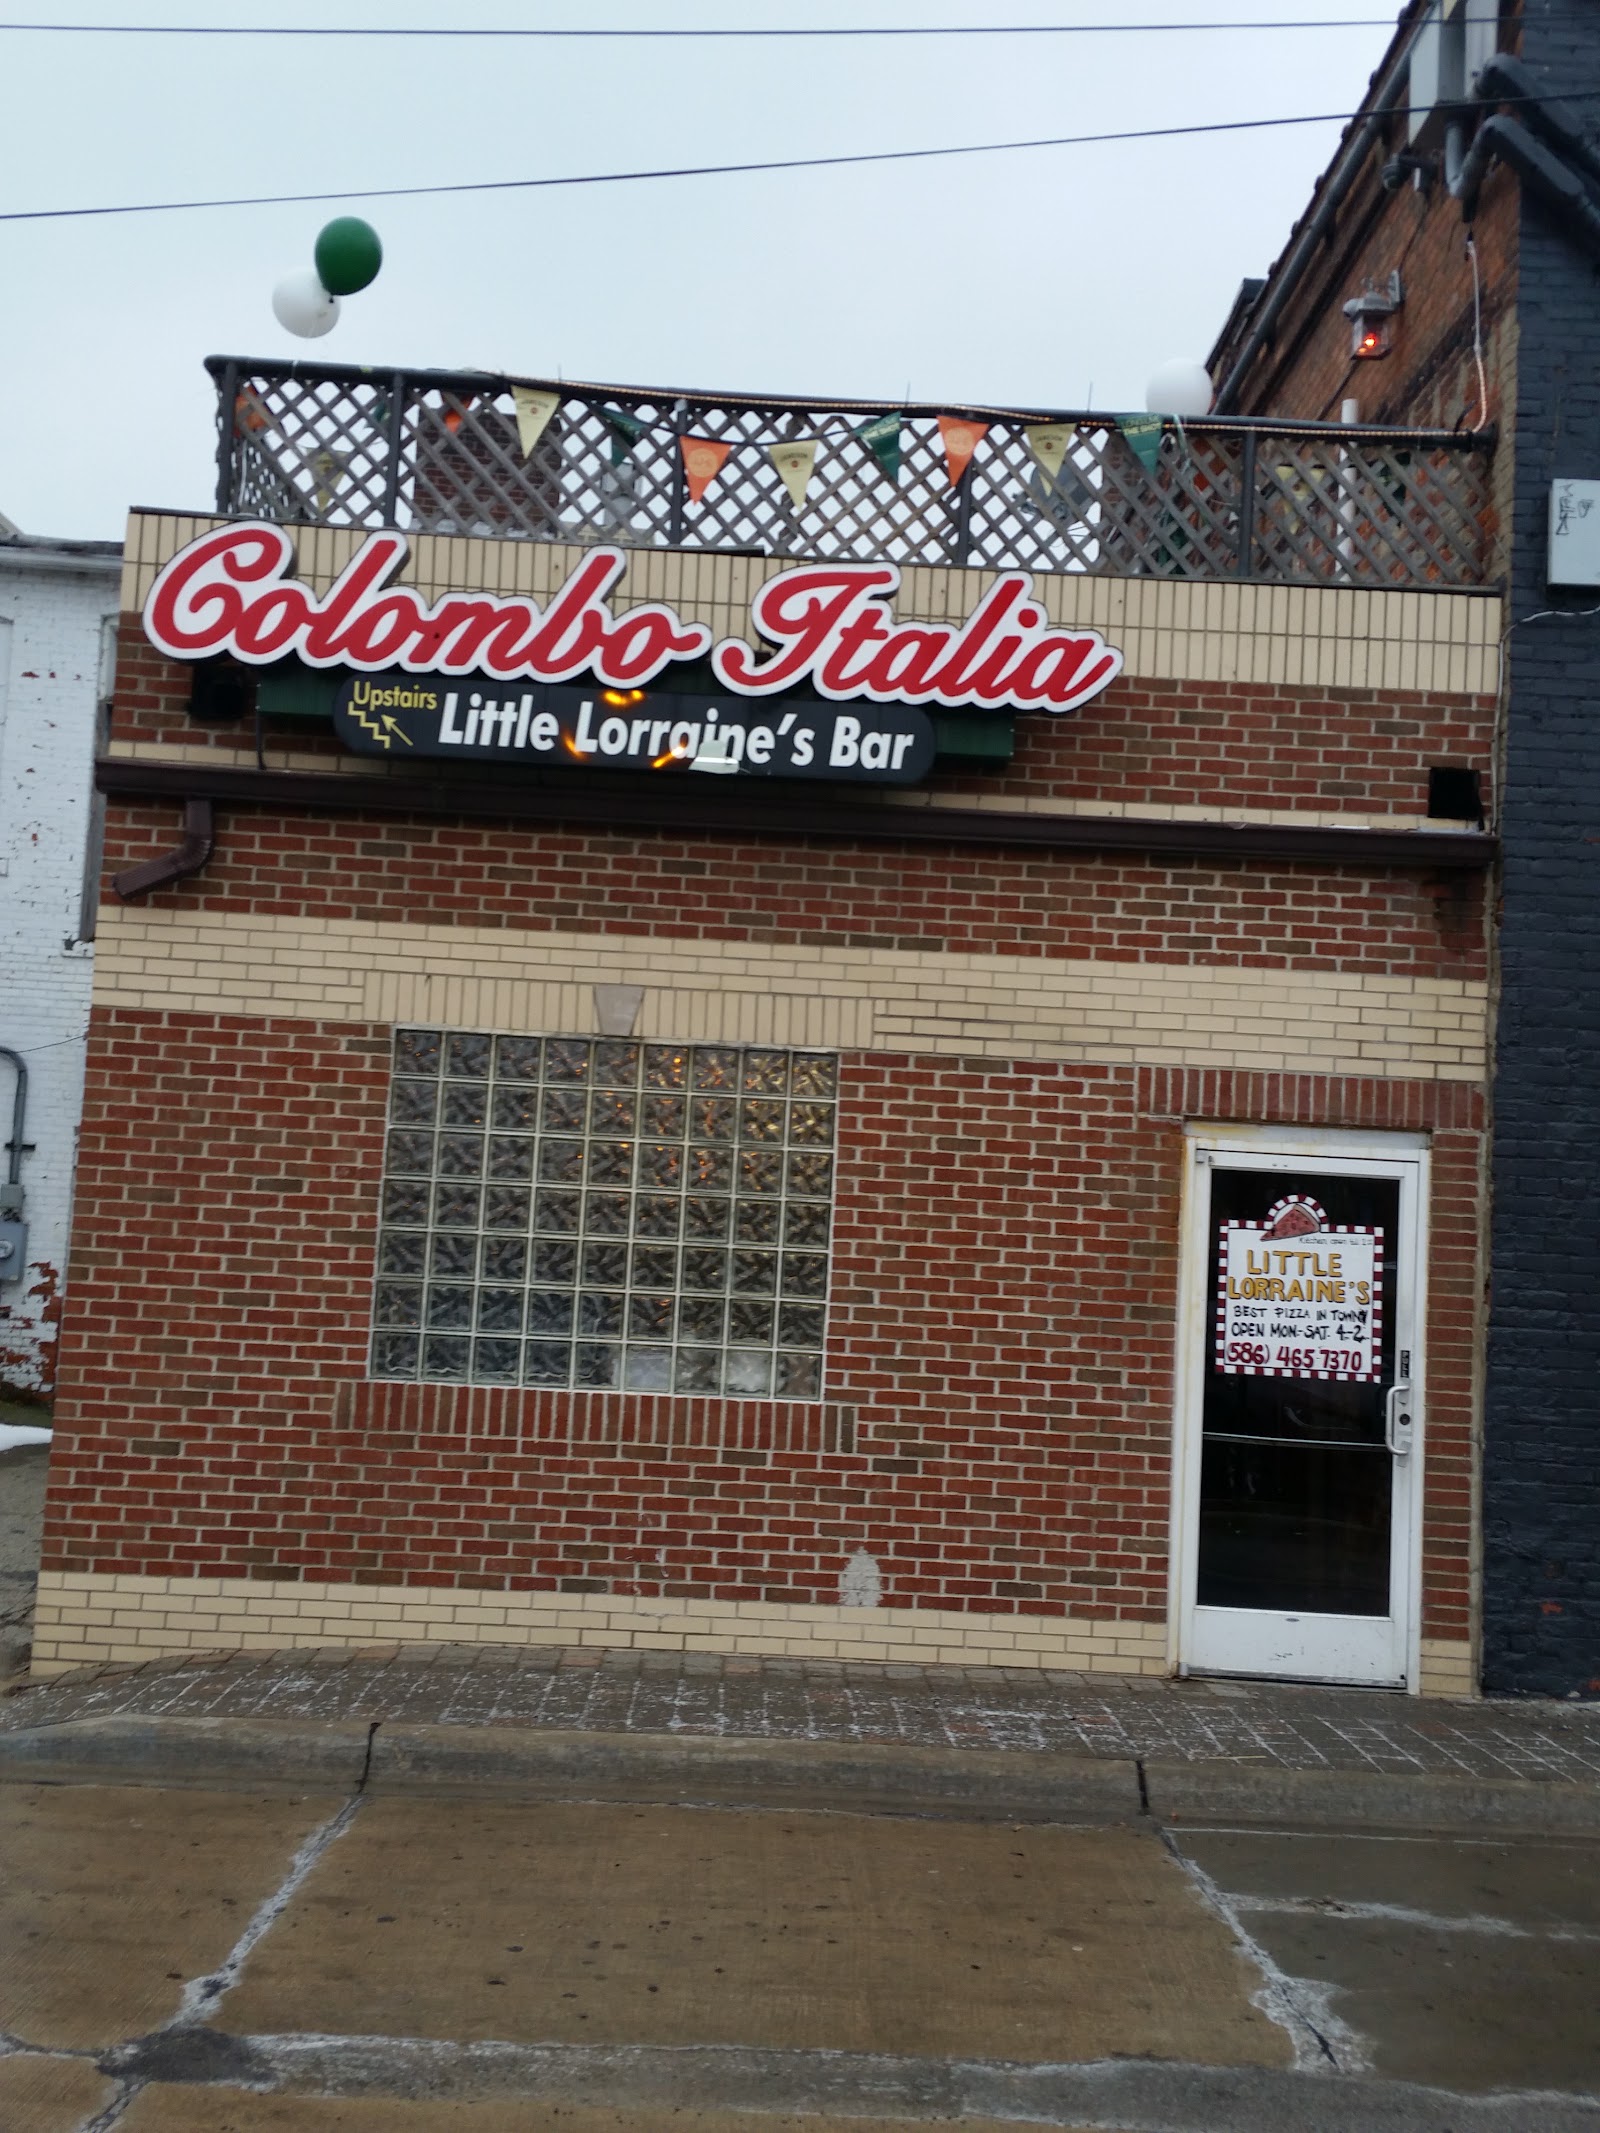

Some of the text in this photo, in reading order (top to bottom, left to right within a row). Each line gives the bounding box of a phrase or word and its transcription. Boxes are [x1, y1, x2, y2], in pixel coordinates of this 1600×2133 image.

[156, 529, 1115, 703] Colombo Italia
[353, 681, 437, 710] Upstairs
[438, 693, 914, 770] Little Lorraine's Bar
[1247, 1249, 1342, 1277] LITTLE
[1228, 1276, 1370, 1305] LORRAINE'S
[1233, 1305, 1267, 1318] BEST
[1274, 1307, 1310, 1319] PIZZA
[1316, 1310, 1327, 1321] IN
[1231, 1322, 1265, 1337] OPEN
[1227, 1342, 1270, 1364] (586)
